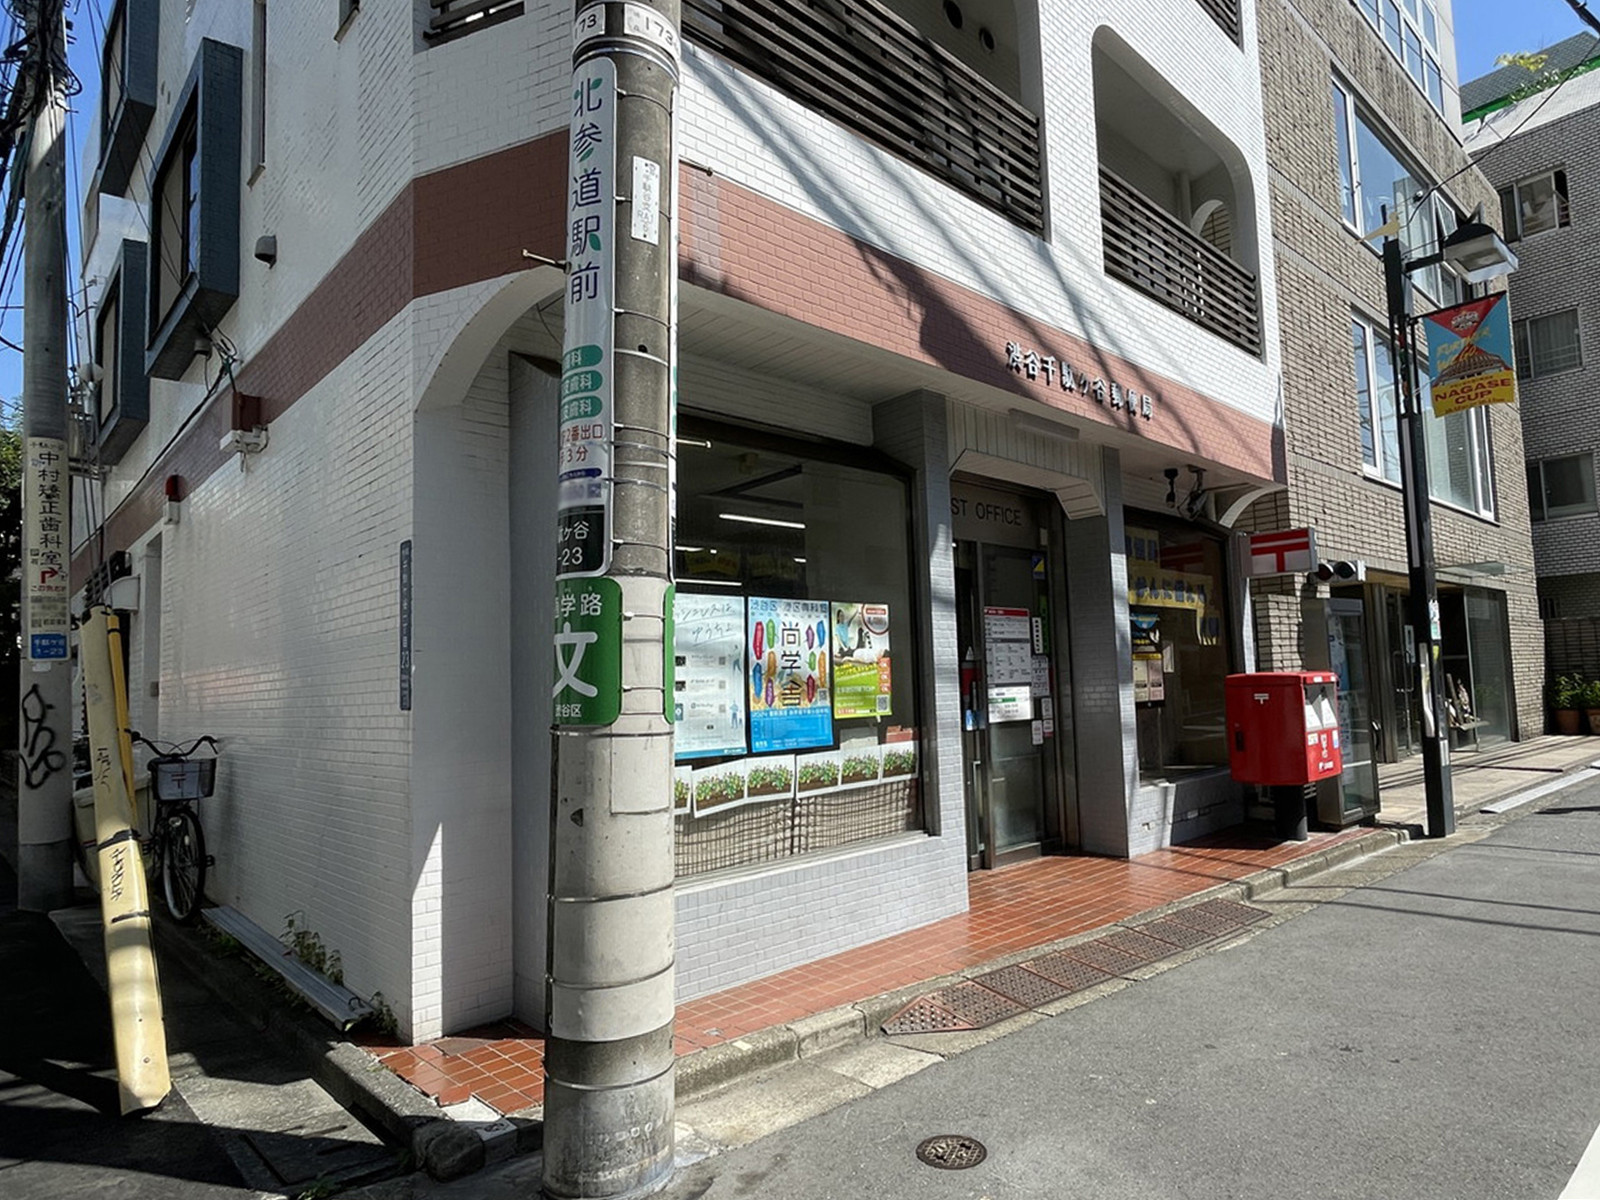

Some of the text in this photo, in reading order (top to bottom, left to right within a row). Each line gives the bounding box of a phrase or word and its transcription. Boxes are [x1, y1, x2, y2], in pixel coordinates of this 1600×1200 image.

[570, 77, 603, 304] 北参道駅前
[1435, 377, 1511, 402] NAGASE
[1455, 389, 1493, 404] CUP
[38, 451, 63, 568] 中村矯正歯科室
[975, 502, 1022, 526] OFFICE
